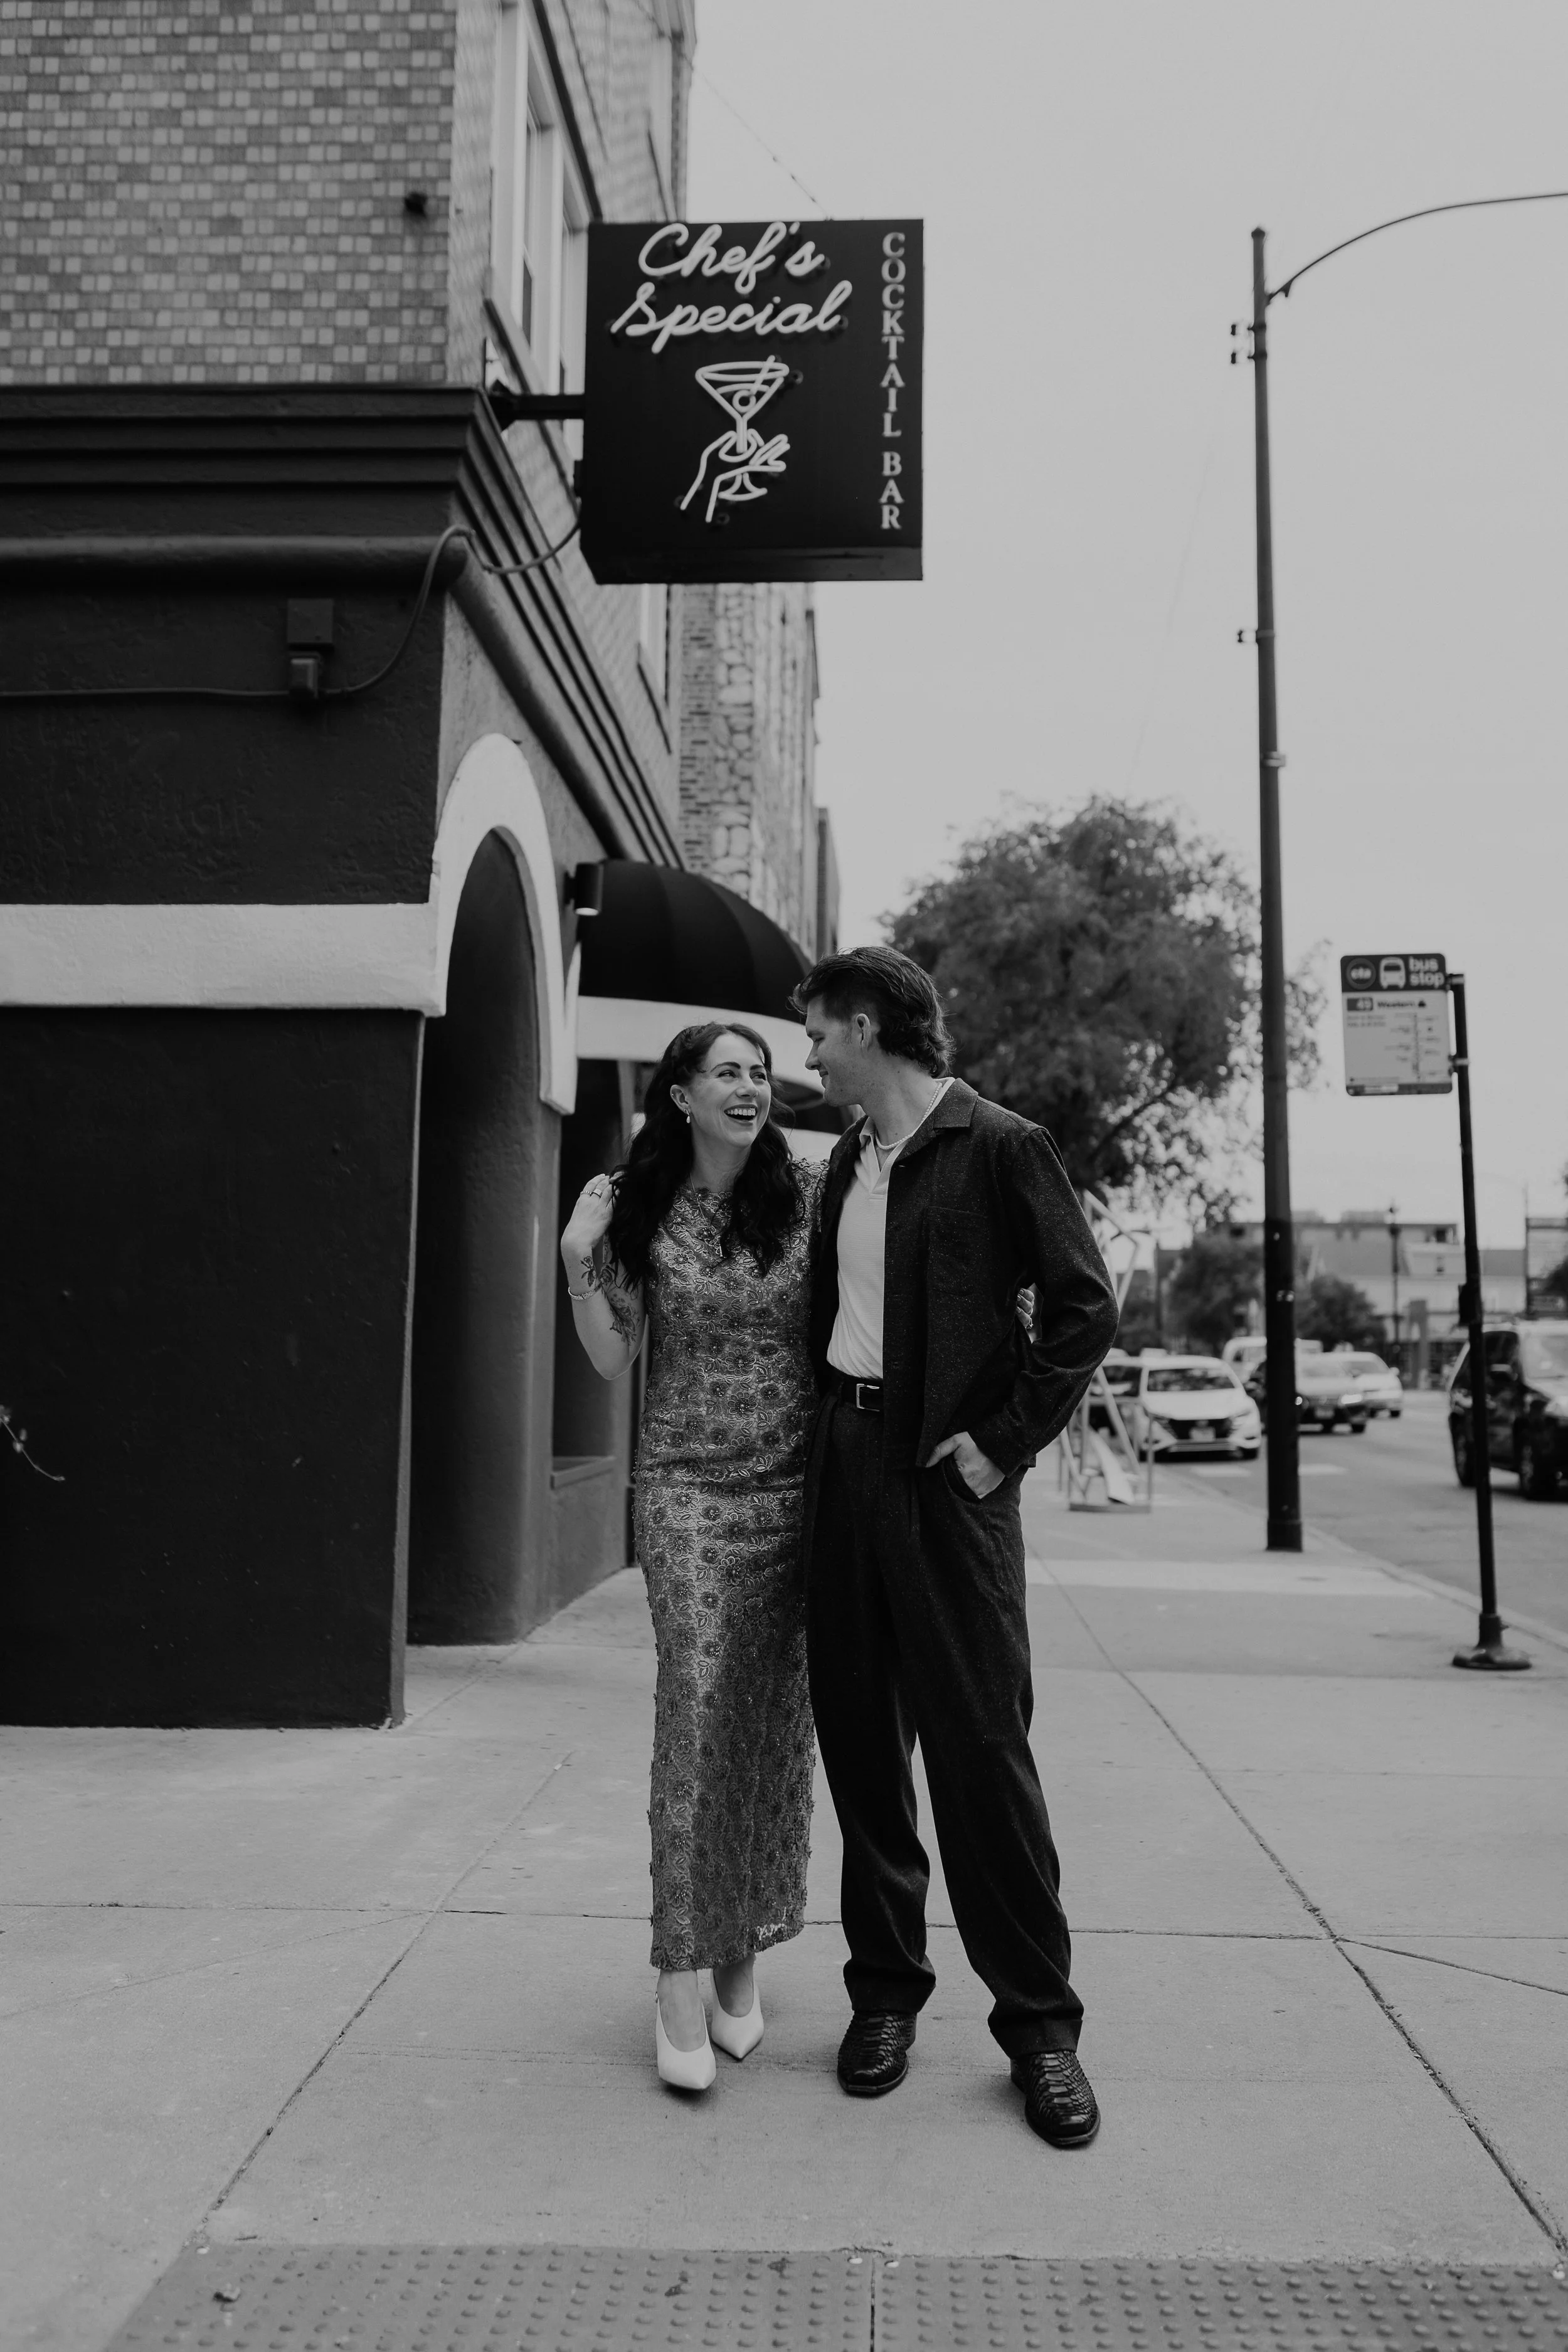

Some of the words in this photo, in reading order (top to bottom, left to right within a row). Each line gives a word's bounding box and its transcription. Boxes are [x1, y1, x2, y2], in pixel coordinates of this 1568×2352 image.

[638, 221, 825, 294] Chef's
[610, 280, 852, 354] Special
[881, 232, 906, 438] COCKTAIL
[879, 452, 903, 530] BAR
[1409, 956, 1439, 972] bus
[1409, 972, 1445, 989] stop
